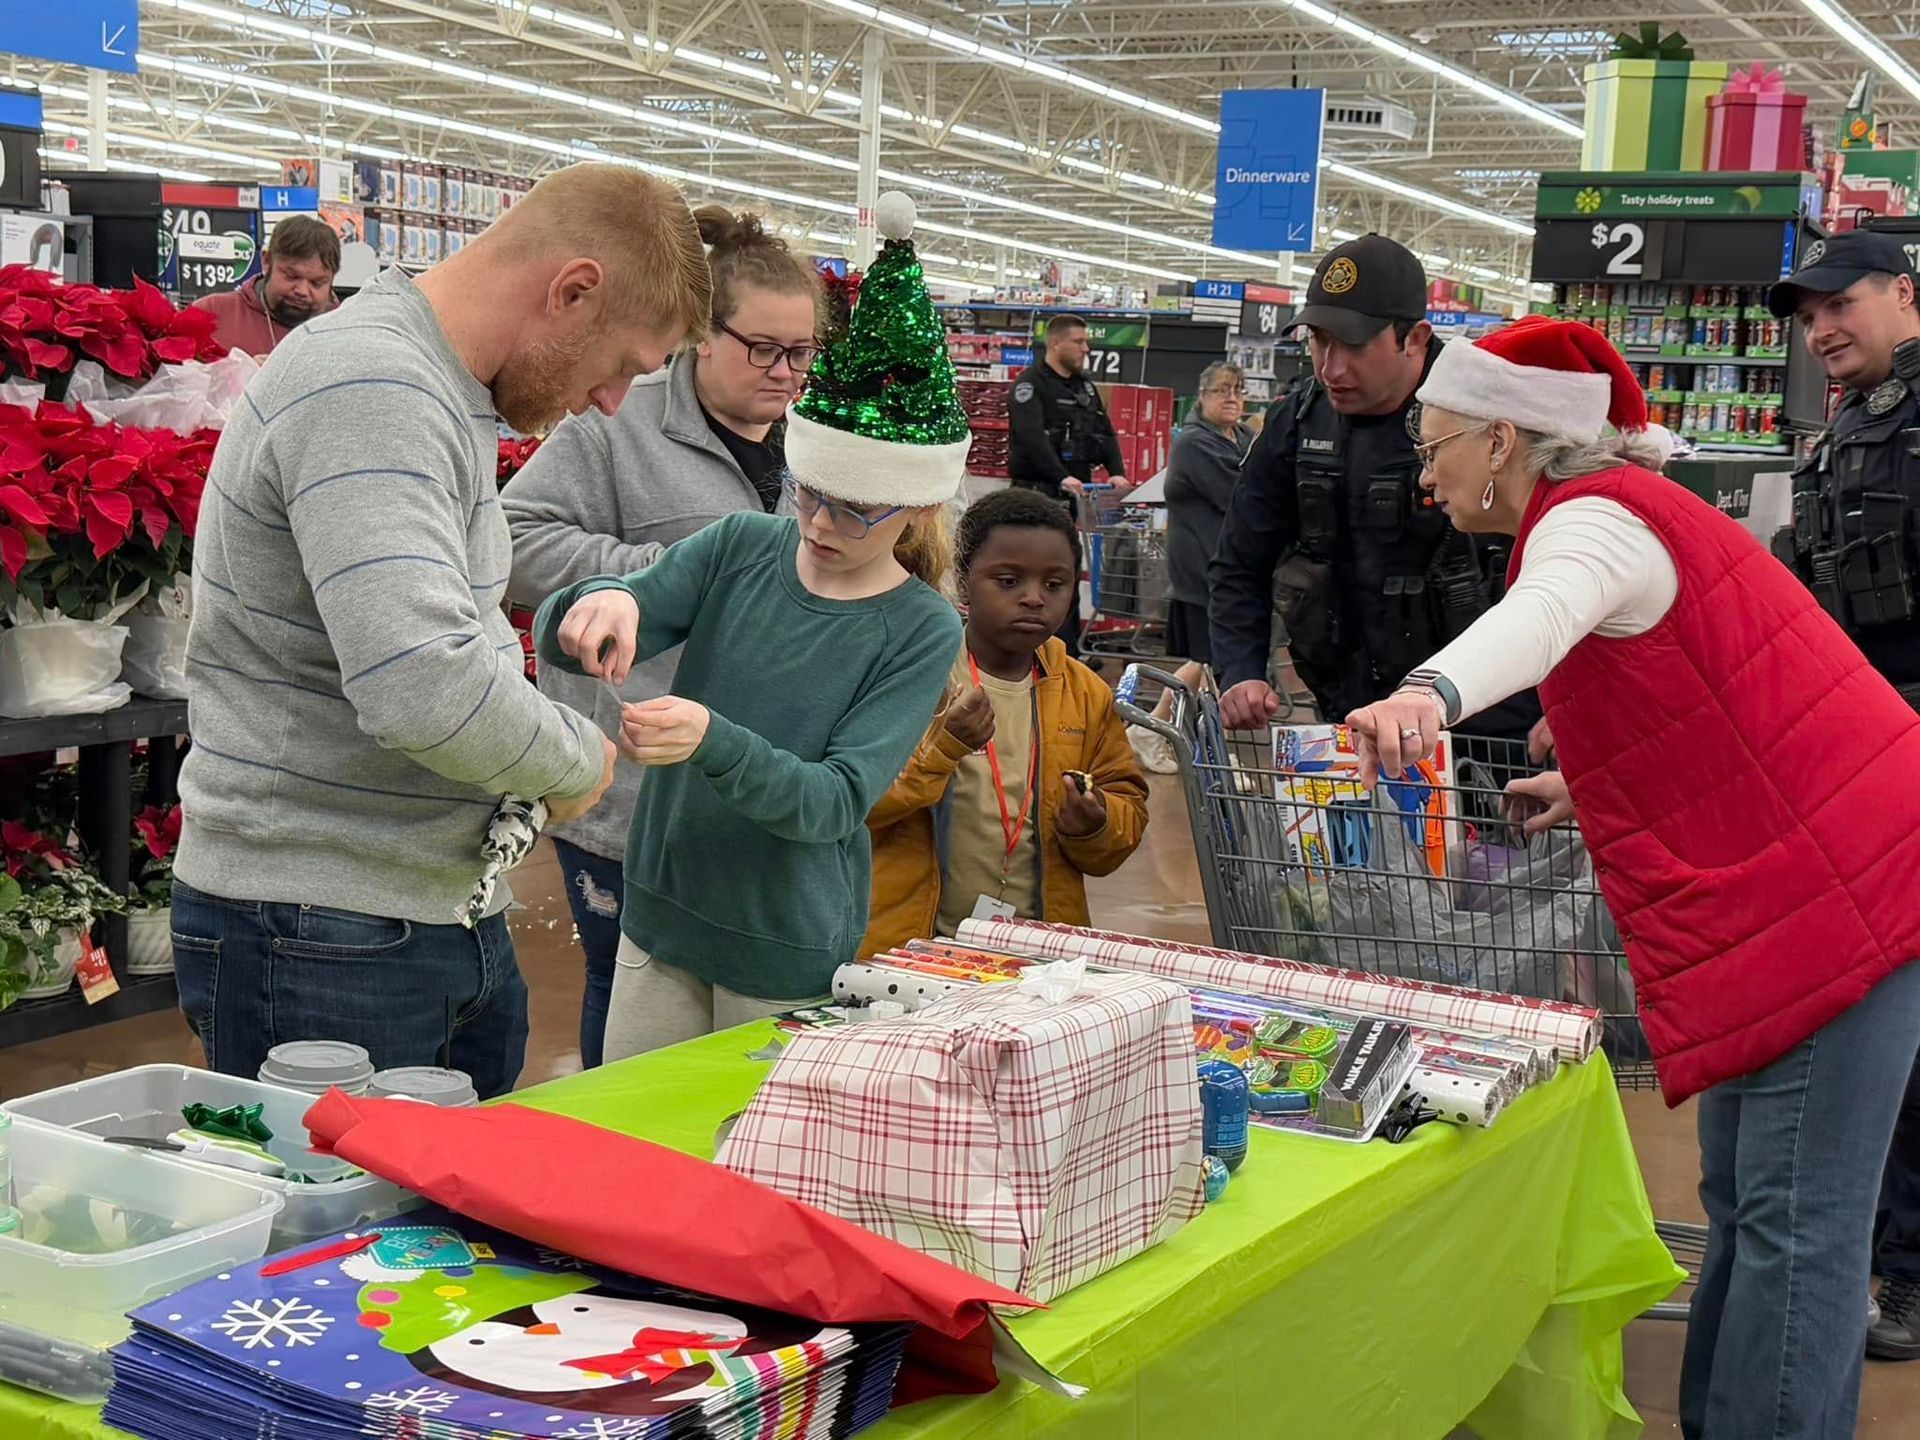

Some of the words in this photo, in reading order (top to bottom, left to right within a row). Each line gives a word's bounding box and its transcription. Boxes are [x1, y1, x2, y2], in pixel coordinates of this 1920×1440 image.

[1225, 167, 1310, 186] Dinnerware
[277, 190, 289, 207] H
[1620, 193, 1646, 207] Tasty
[1646, 194, 1683, 207] holiday
[1684, 194, 1714, 205] treats
[1590, 221, 1645, 276] $2
[1207, 283, 1217, 296] H
[1220, 284, 1232, 297] 21
[1432, 312, 1442, 323] H
[1083, 350, 1120, 374] 72
[1339, 1056, 1368, 1091] WALKIE
[383, 1233, 418, 1250] BE
[396, 1232, 460, 1264] MERRY
